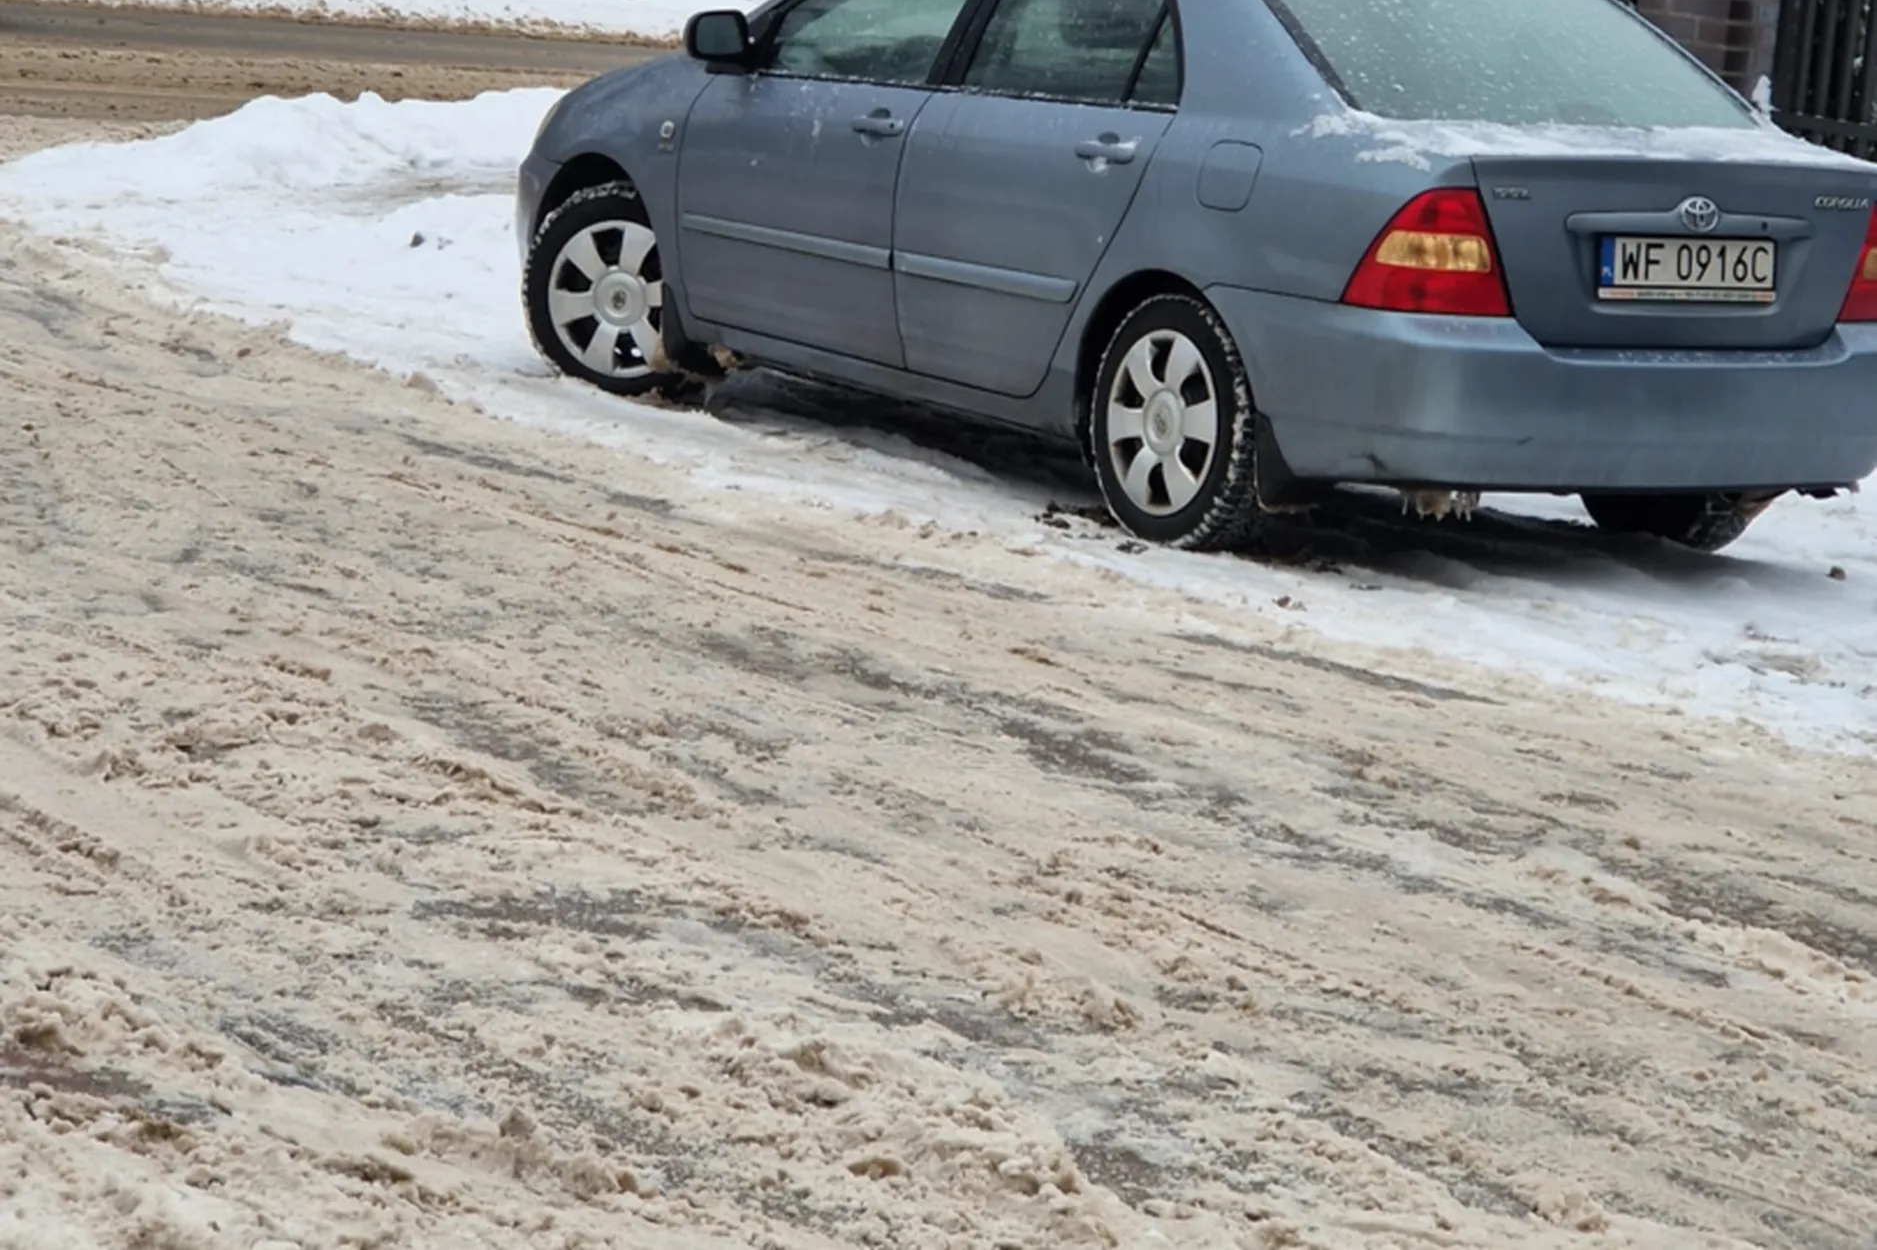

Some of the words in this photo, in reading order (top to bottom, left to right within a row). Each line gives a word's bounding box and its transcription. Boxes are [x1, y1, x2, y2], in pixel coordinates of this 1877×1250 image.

[1814, 194, 1869, 210] COROLLA
[1621, 241, 1666, 281] WF
[1676, 243, 1770, 284] 0916C
